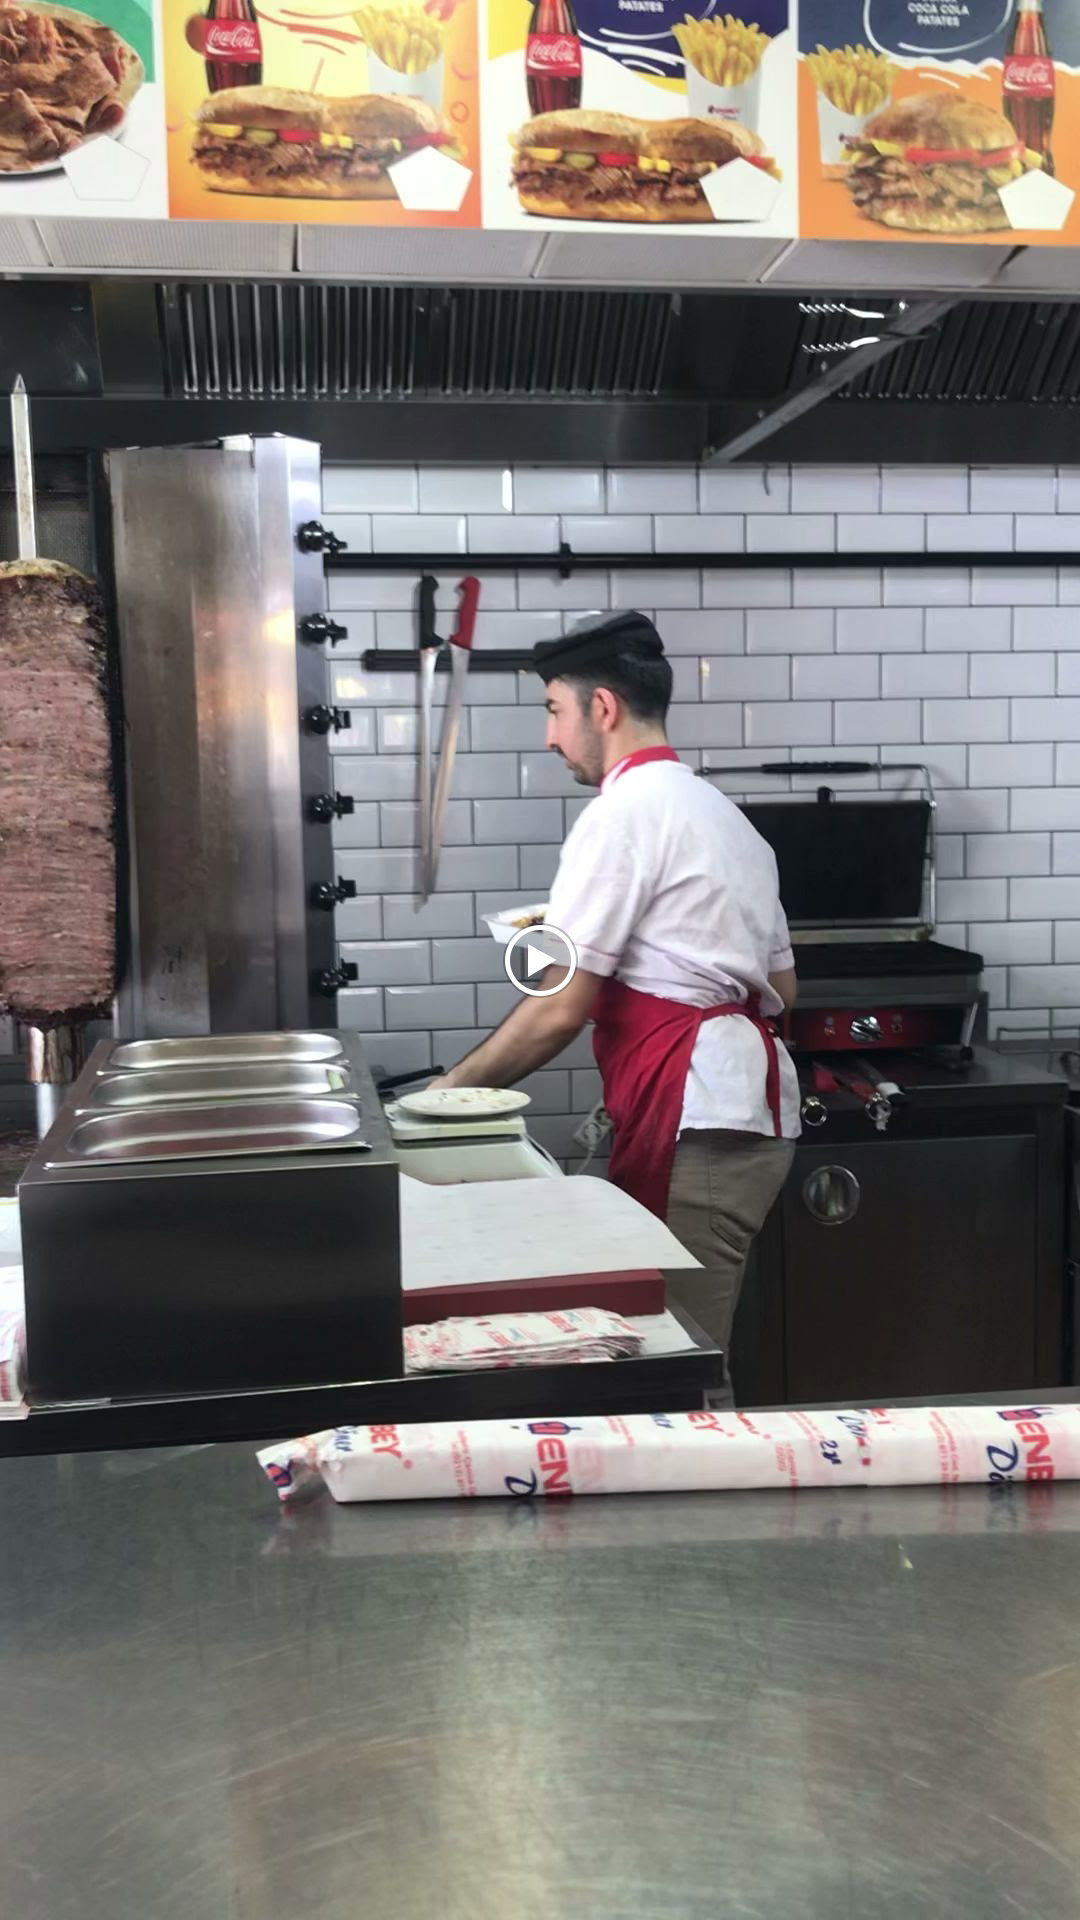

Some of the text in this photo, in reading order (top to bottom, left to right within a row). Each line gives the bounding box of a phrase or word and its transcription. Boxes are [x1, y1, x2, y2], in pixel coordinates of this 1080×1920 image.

[618, 0, 664, 13] PATATES
[907, 2, 970, 16] COCA COLA
[916, 14, 960, 27] PATATES
